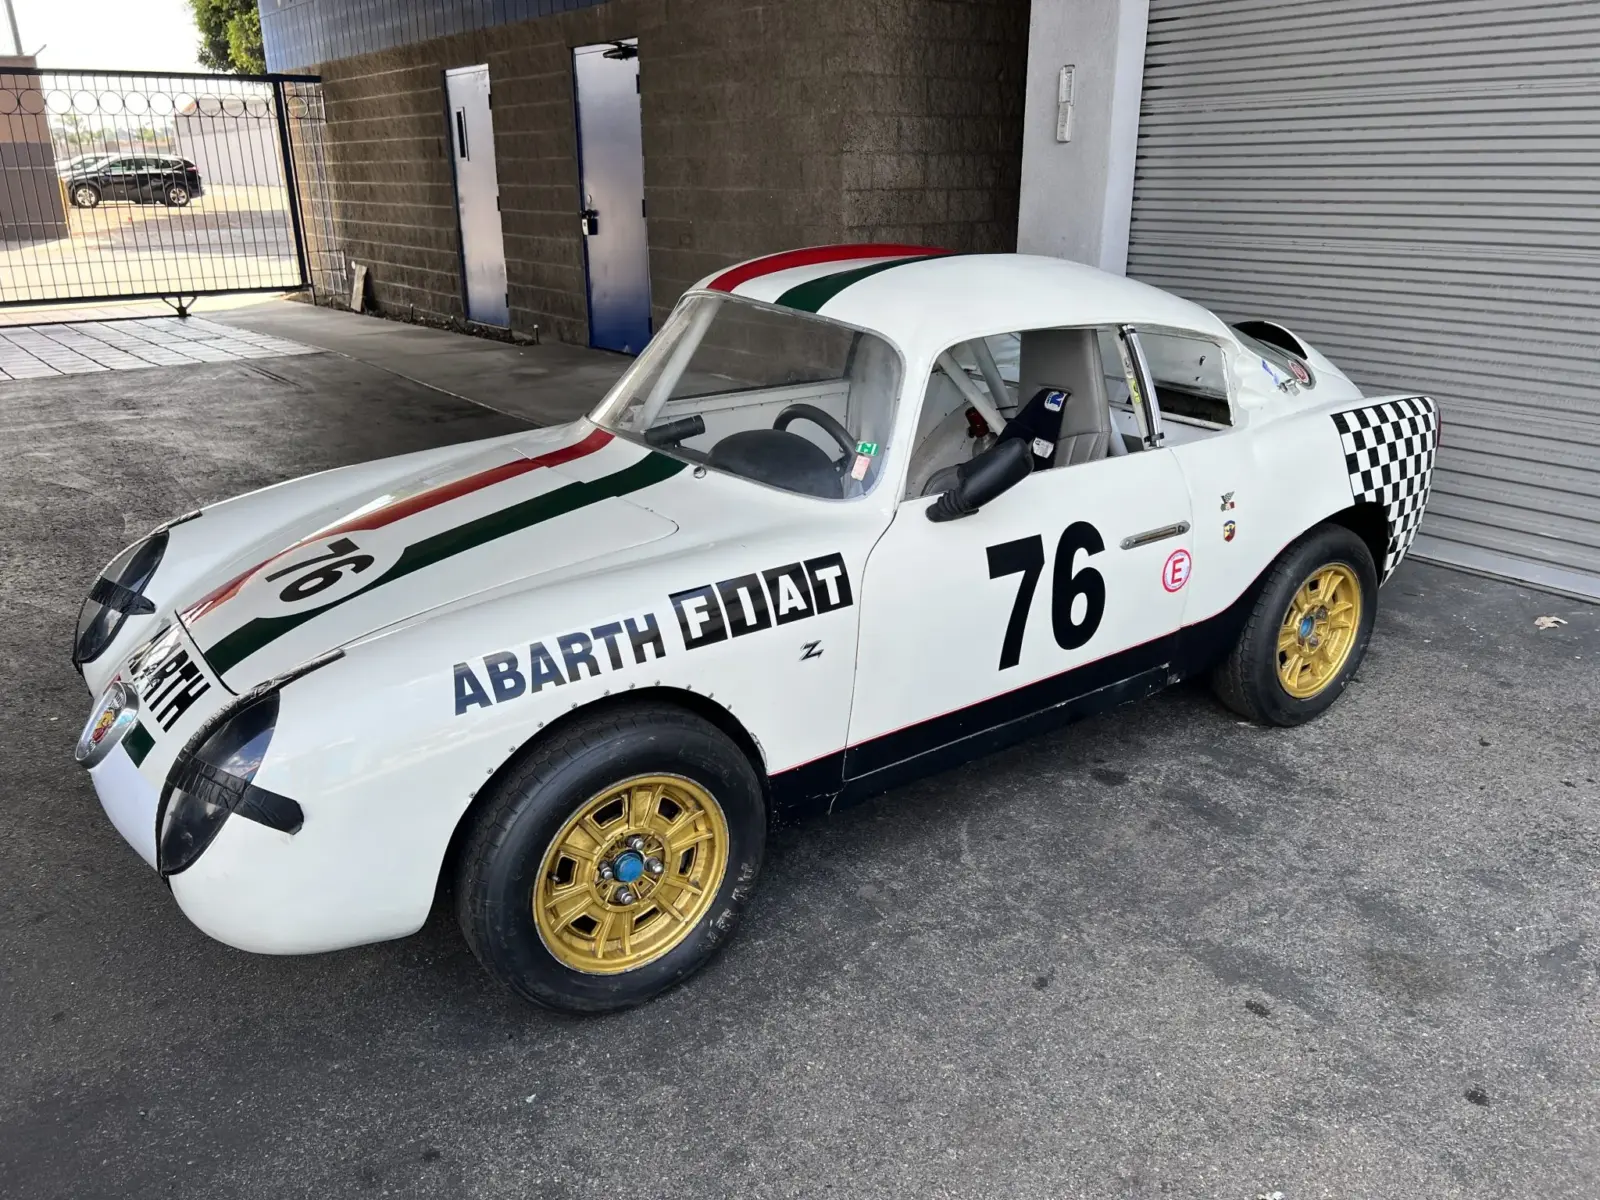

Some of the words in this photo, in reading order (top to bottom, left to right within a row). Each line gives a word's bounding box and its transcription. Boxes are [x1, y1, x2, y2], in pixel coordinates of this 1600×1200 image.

[264, 537, 375, 602] 76
[985, 520, 1106, 672] 76
[1171, 557, 1185, 585] E
[452, 612, 667, 717] ABARTH
[680, 563, 844, 641] FIAT
[800, 639, 824, 662] Z
